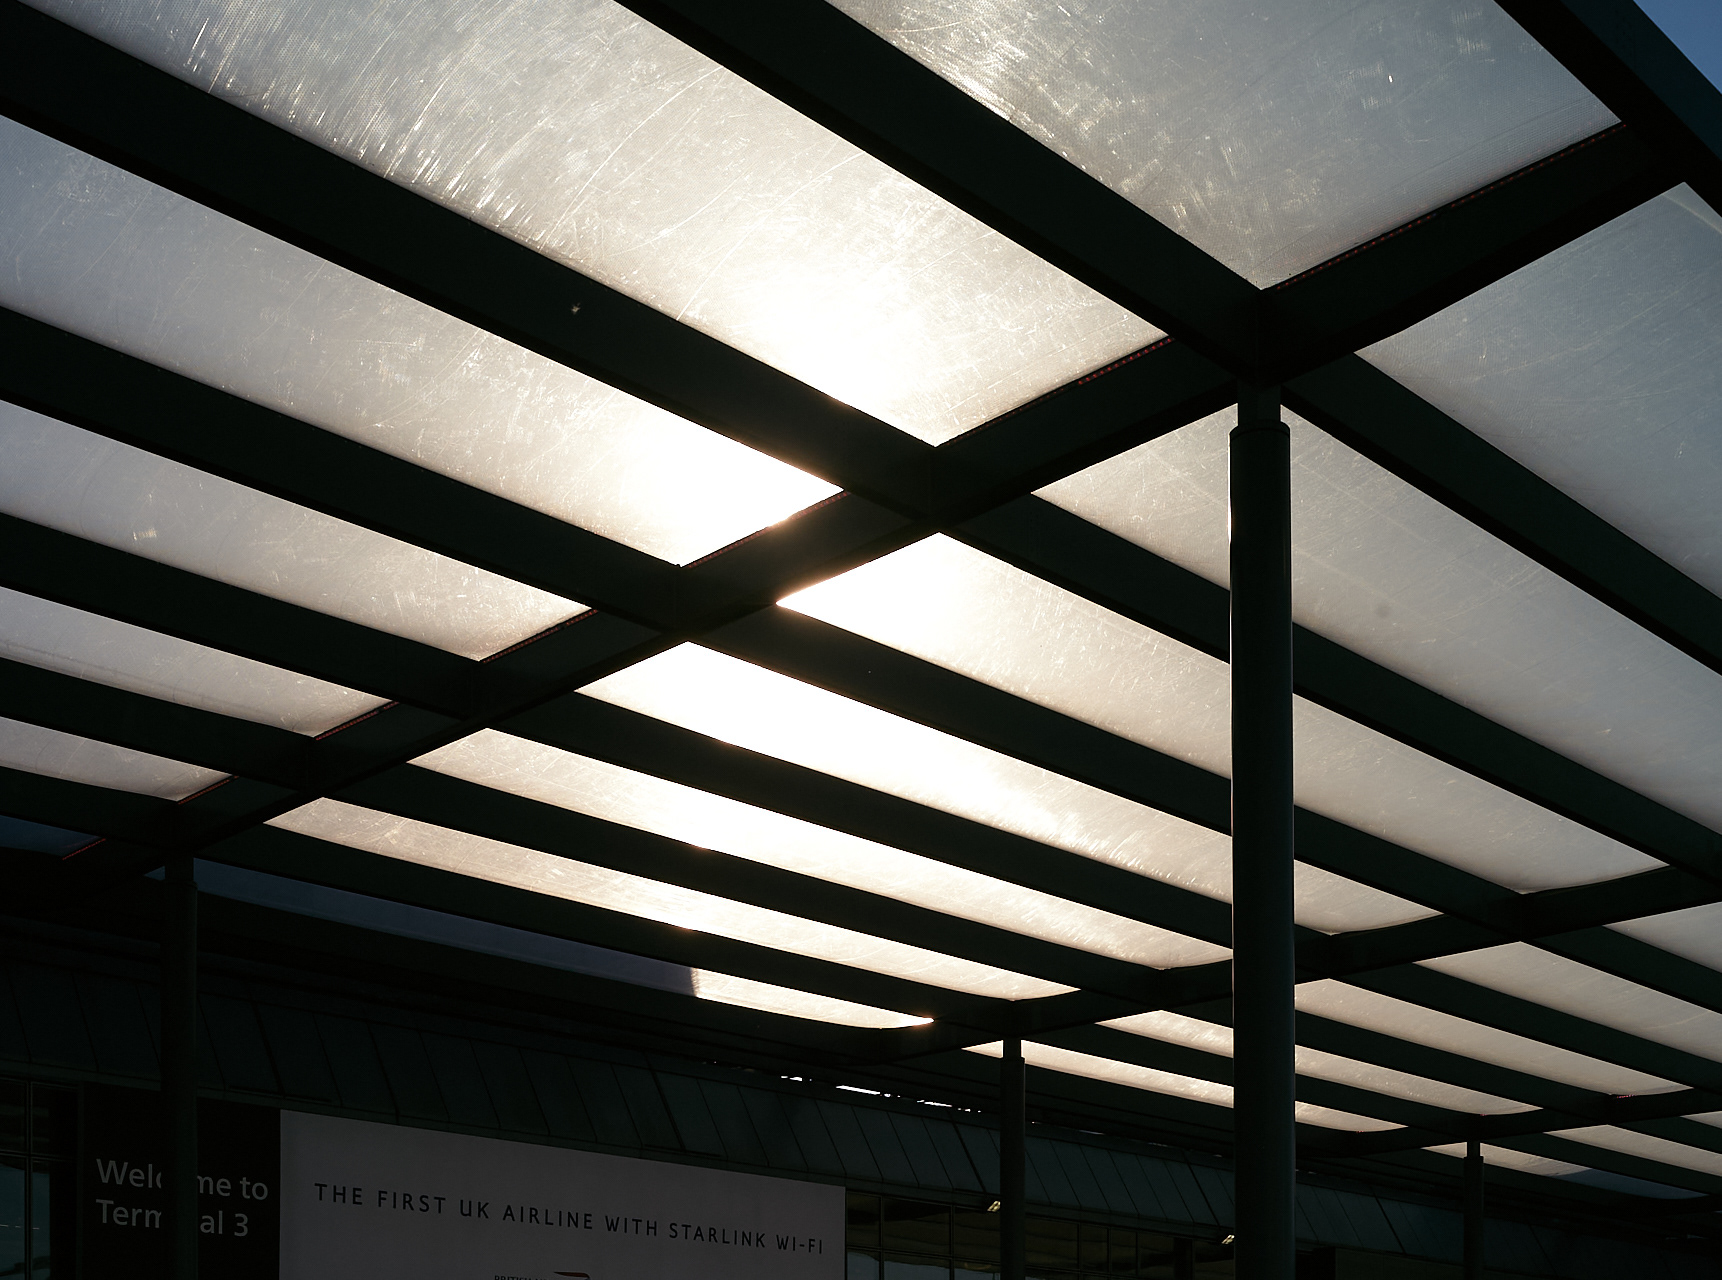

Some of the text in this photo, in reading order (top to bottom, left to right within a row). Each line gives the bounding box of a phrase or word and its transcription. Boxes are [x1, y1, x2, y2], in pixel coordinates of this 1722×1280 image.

[95, 1157, 268, 1201] Welme to
[95, 1198, 249, 1237] Termal 3
[315, 1183, 821, 1254] THE FIRST UK AIRLINE WITH STARLINK WI-FI
